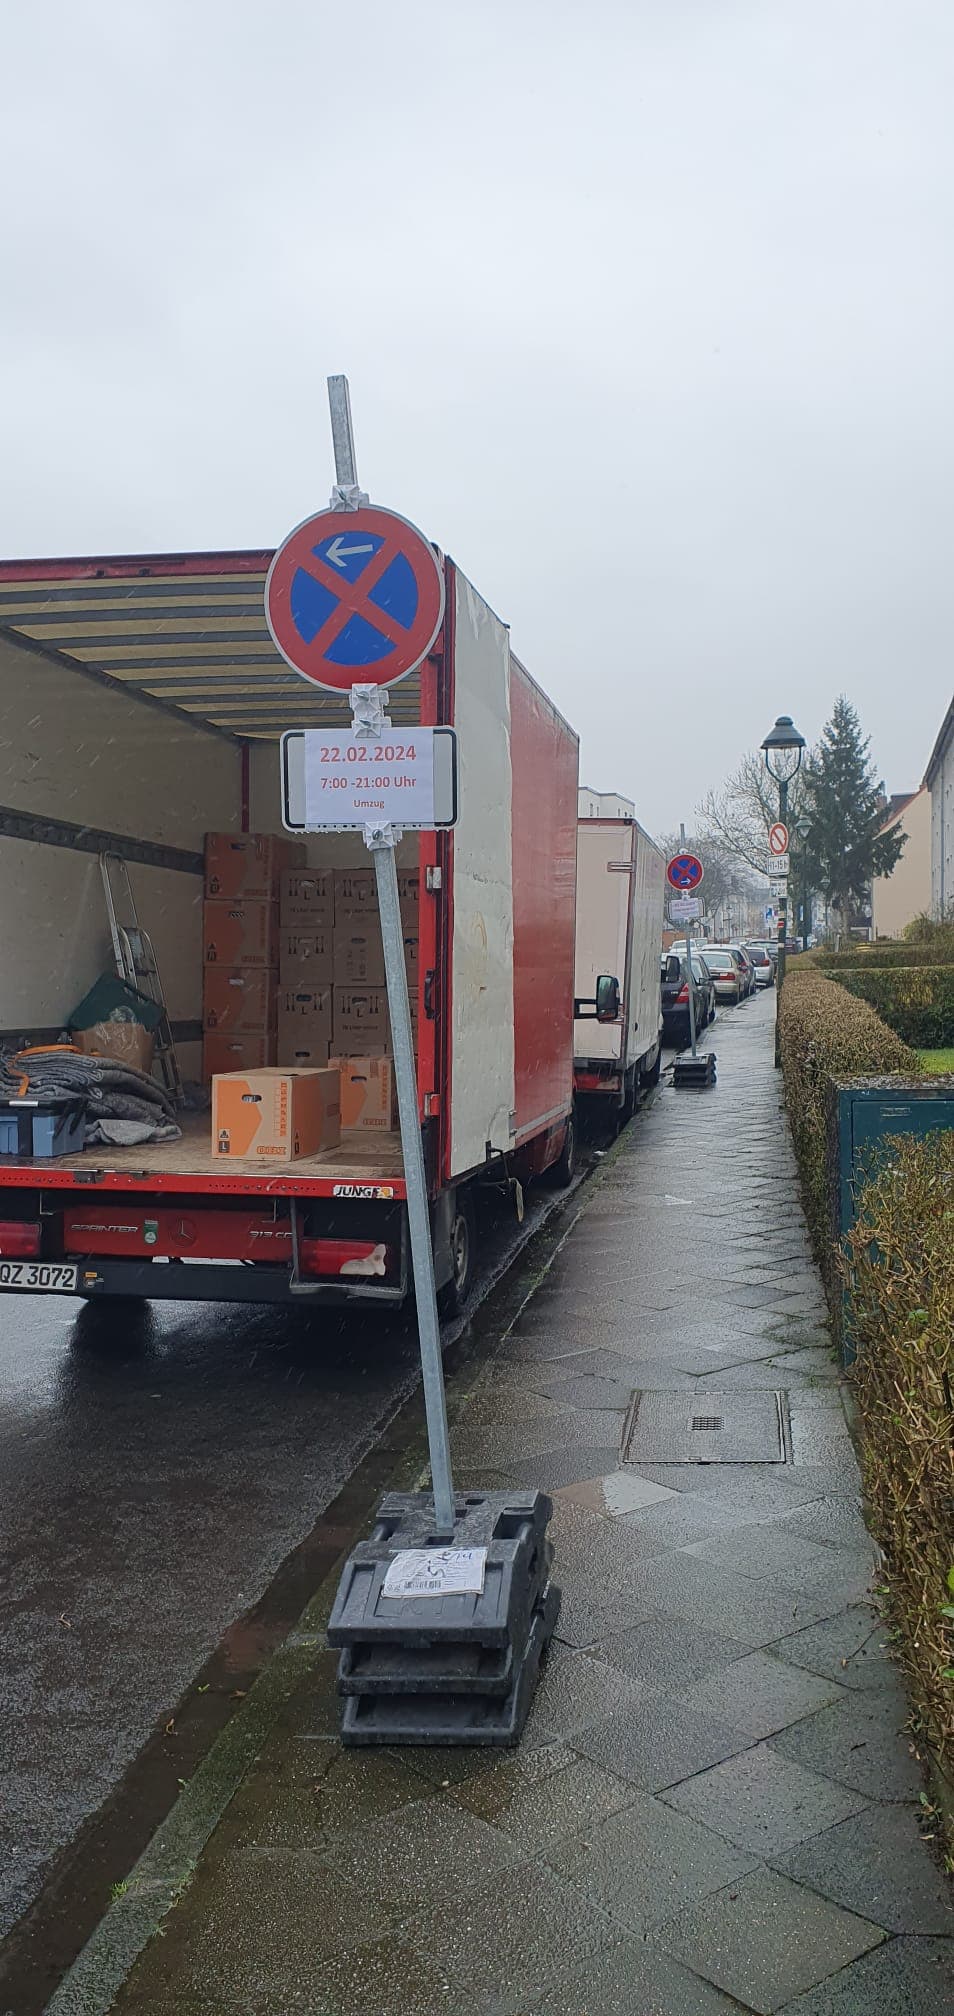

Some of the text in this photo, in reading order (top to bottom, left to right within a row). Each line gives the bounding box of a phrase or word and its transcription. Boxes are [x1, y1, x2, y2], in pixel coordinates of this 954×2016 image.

[320, 745, 417, 763] 22.02.2024
[321, 777, 348, 789] 7:00
[394, 775, 417, 788] Uhr
[353, 799, 385, 809] Umzug
[71, 1224, 138, 1233] SPRINTER
[0, 1264, 75, 1288] QZ 3072
